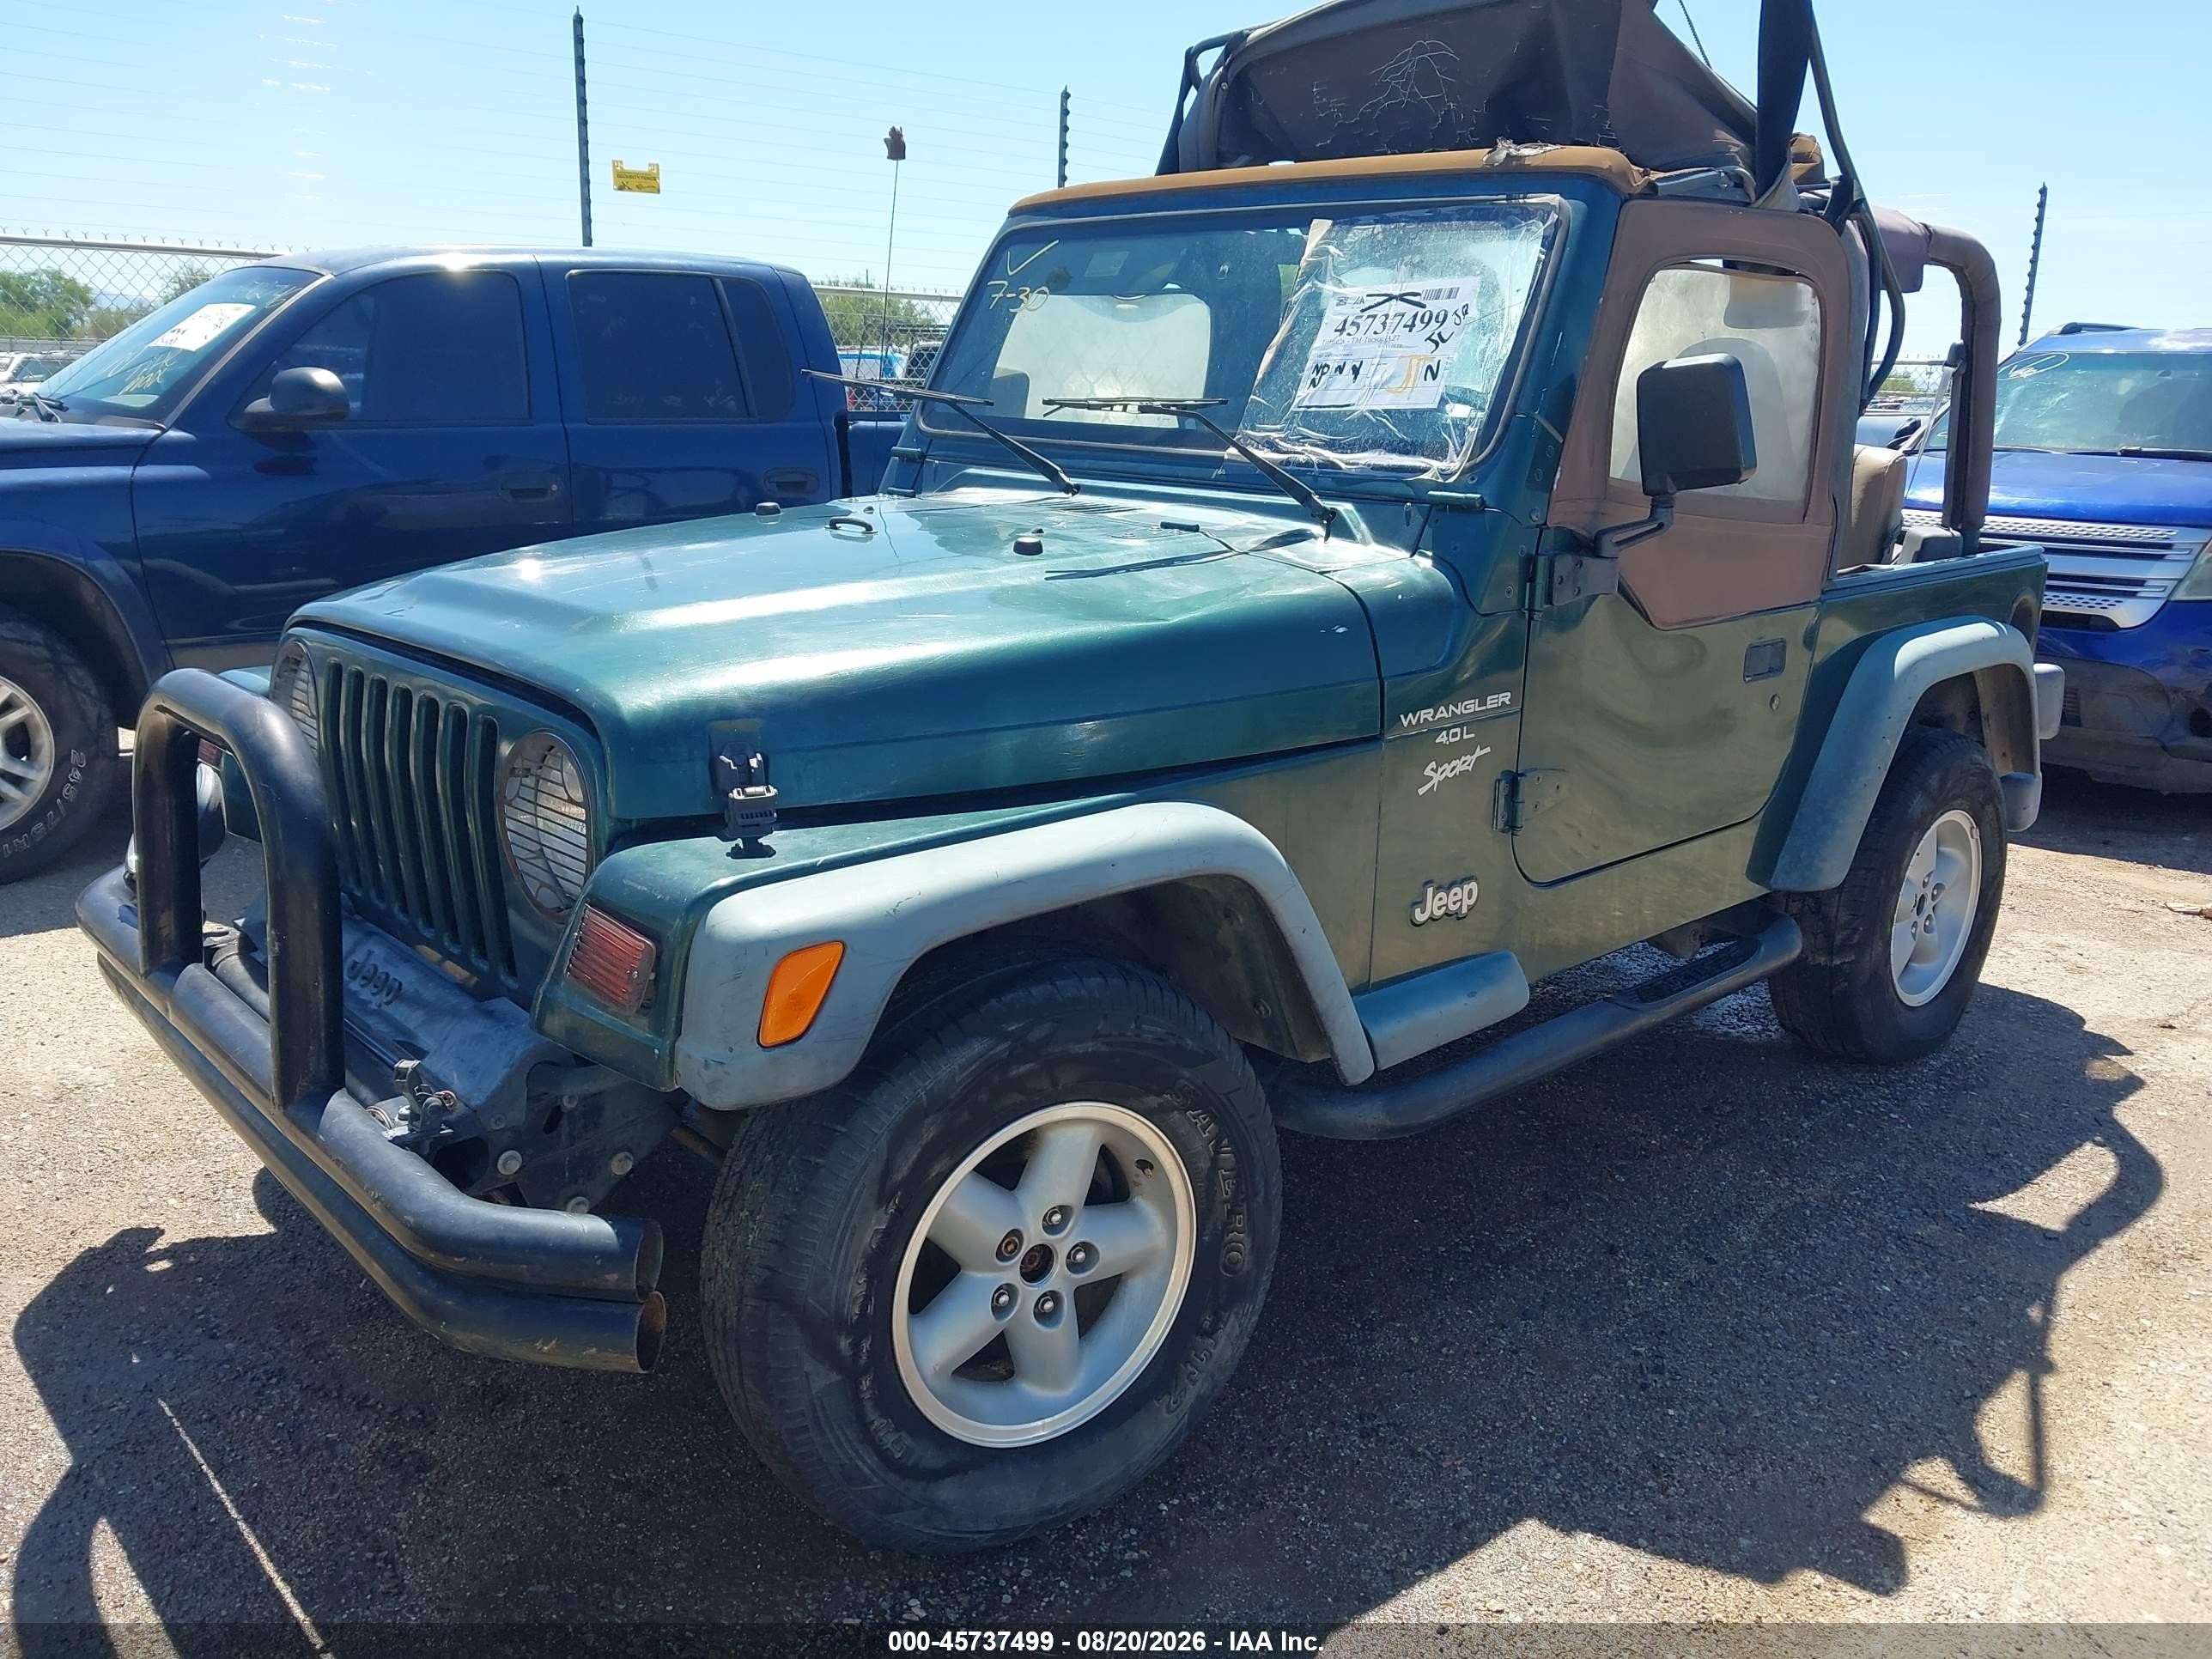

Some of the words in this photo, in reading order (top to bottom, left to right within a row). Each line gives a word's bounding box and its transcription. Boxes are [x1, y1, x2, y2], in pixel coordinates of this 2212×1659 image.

[988, 280, 1049, 313] 7-30
[1334, 309, 1449, 337] 45737499
[1424, 359, 1442, 382] N
[1400, 691, 1511, 728] WRANGLER
[1418, 744, 1491, 795] Sport
[1412, 879, 1479, 925] Jeep
[346, 949, 404, 1006] Jeep
